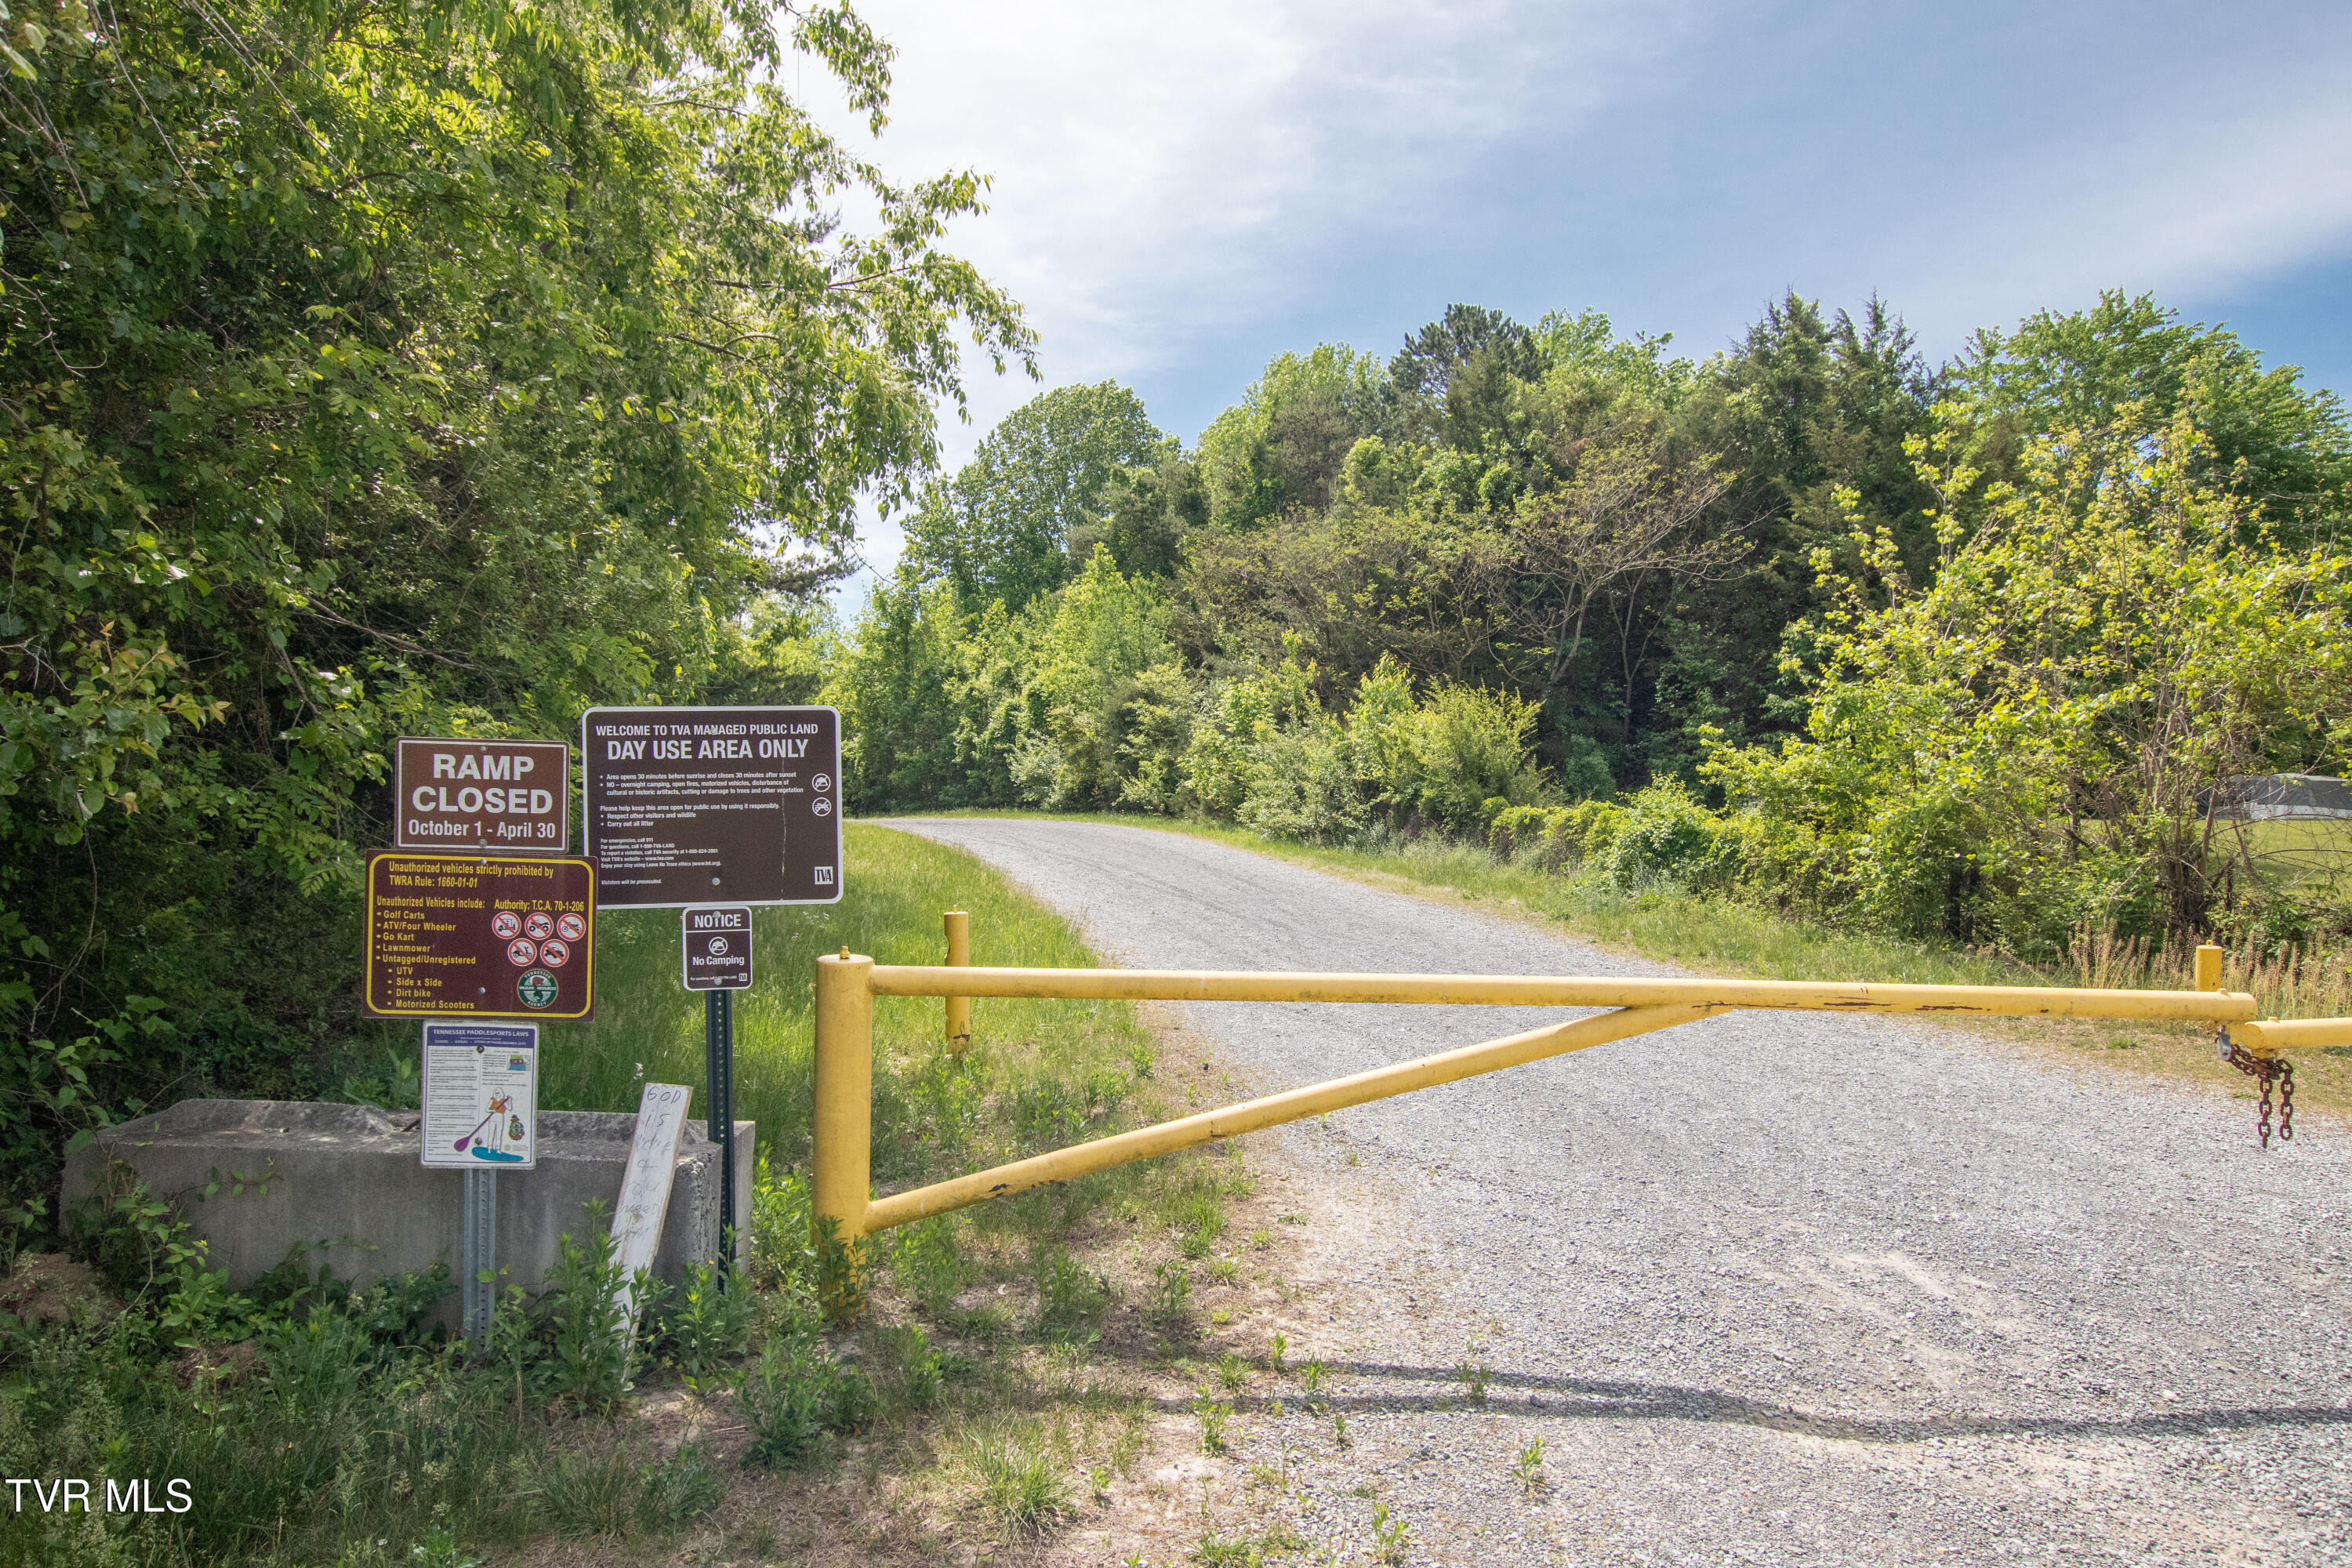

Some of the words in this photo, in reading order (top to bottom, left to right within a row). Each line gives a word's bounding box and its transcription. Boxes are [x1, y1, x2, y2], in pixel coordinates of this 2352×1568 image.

[596, 725, 650, 736] WELCOME
[653, 725, 667, 735] TO
[670, 725, 691, 735] TVA
[694, 724, 746, 735] MANAGED
[750, 724, 787, 735] PUBLIC
[790, 724, 818, 734] LAND
[607, 740, 646, 760] DAY
[653, 739, 692, 760] USE
[698, 739, 753, 759] AREA
[759, 739, 808, 758] ONLY
[433, 753, 535, 781] RAMP
[412, 786, 553, 814] CLOSED
[408, 818, 469, 836] October
[474, 821, 481, 836] 1
[496, 822, 532, 840] April
[536, 822, 556, 838] 30
[389, 861, 440, 873] Unauthorized
[442, 862, 474, 874] vehicles
[476, 864, 502, 877] strictly
[504, 865, 543, 877] prohibited
[545, 866, 554, 879] by
[815, 868, 833, 883] TVA
[389, 875, 412, 886] TWRA
[415, 876, 434, 887] Rule:
[438, 877, 477, 887] 1660-01-01
[377, 895, 423, 907] Unauthorized
[426, 896, 455, 908] Vehicles
[457, 897, 485, 909] include:
[495, 898, 530, 912] Authority:
[532, 900, 552, 911] T.C.A.
[554, 901, 584, 912] 70-1-206
[383, 910, 401, 919] Golf
[404, 910, 425, 919] Carts
[695, 913, 742, 928] NOTICE
[383, 921, 420, 931] ATV/Four
[423, 922, 456, 931] Wheeler
[397, 932, 415, 941] Kart
[383, 943, 430, 952] Lawnmower
[383, 954, 476, 965] Untagged/Unregistered
[692, 956, 704, 965] No
[706, 955, 744, 966] Camping
[396, 978, 414, 986] Side
[424, 978, 442, 986] Side
[414, 989, 431, 997] bike
[396, 1000, 436, 1008] Motorized
[438, 1000, 474, 1009] Scooters
[648, 1086, 681, 1104] GOD
